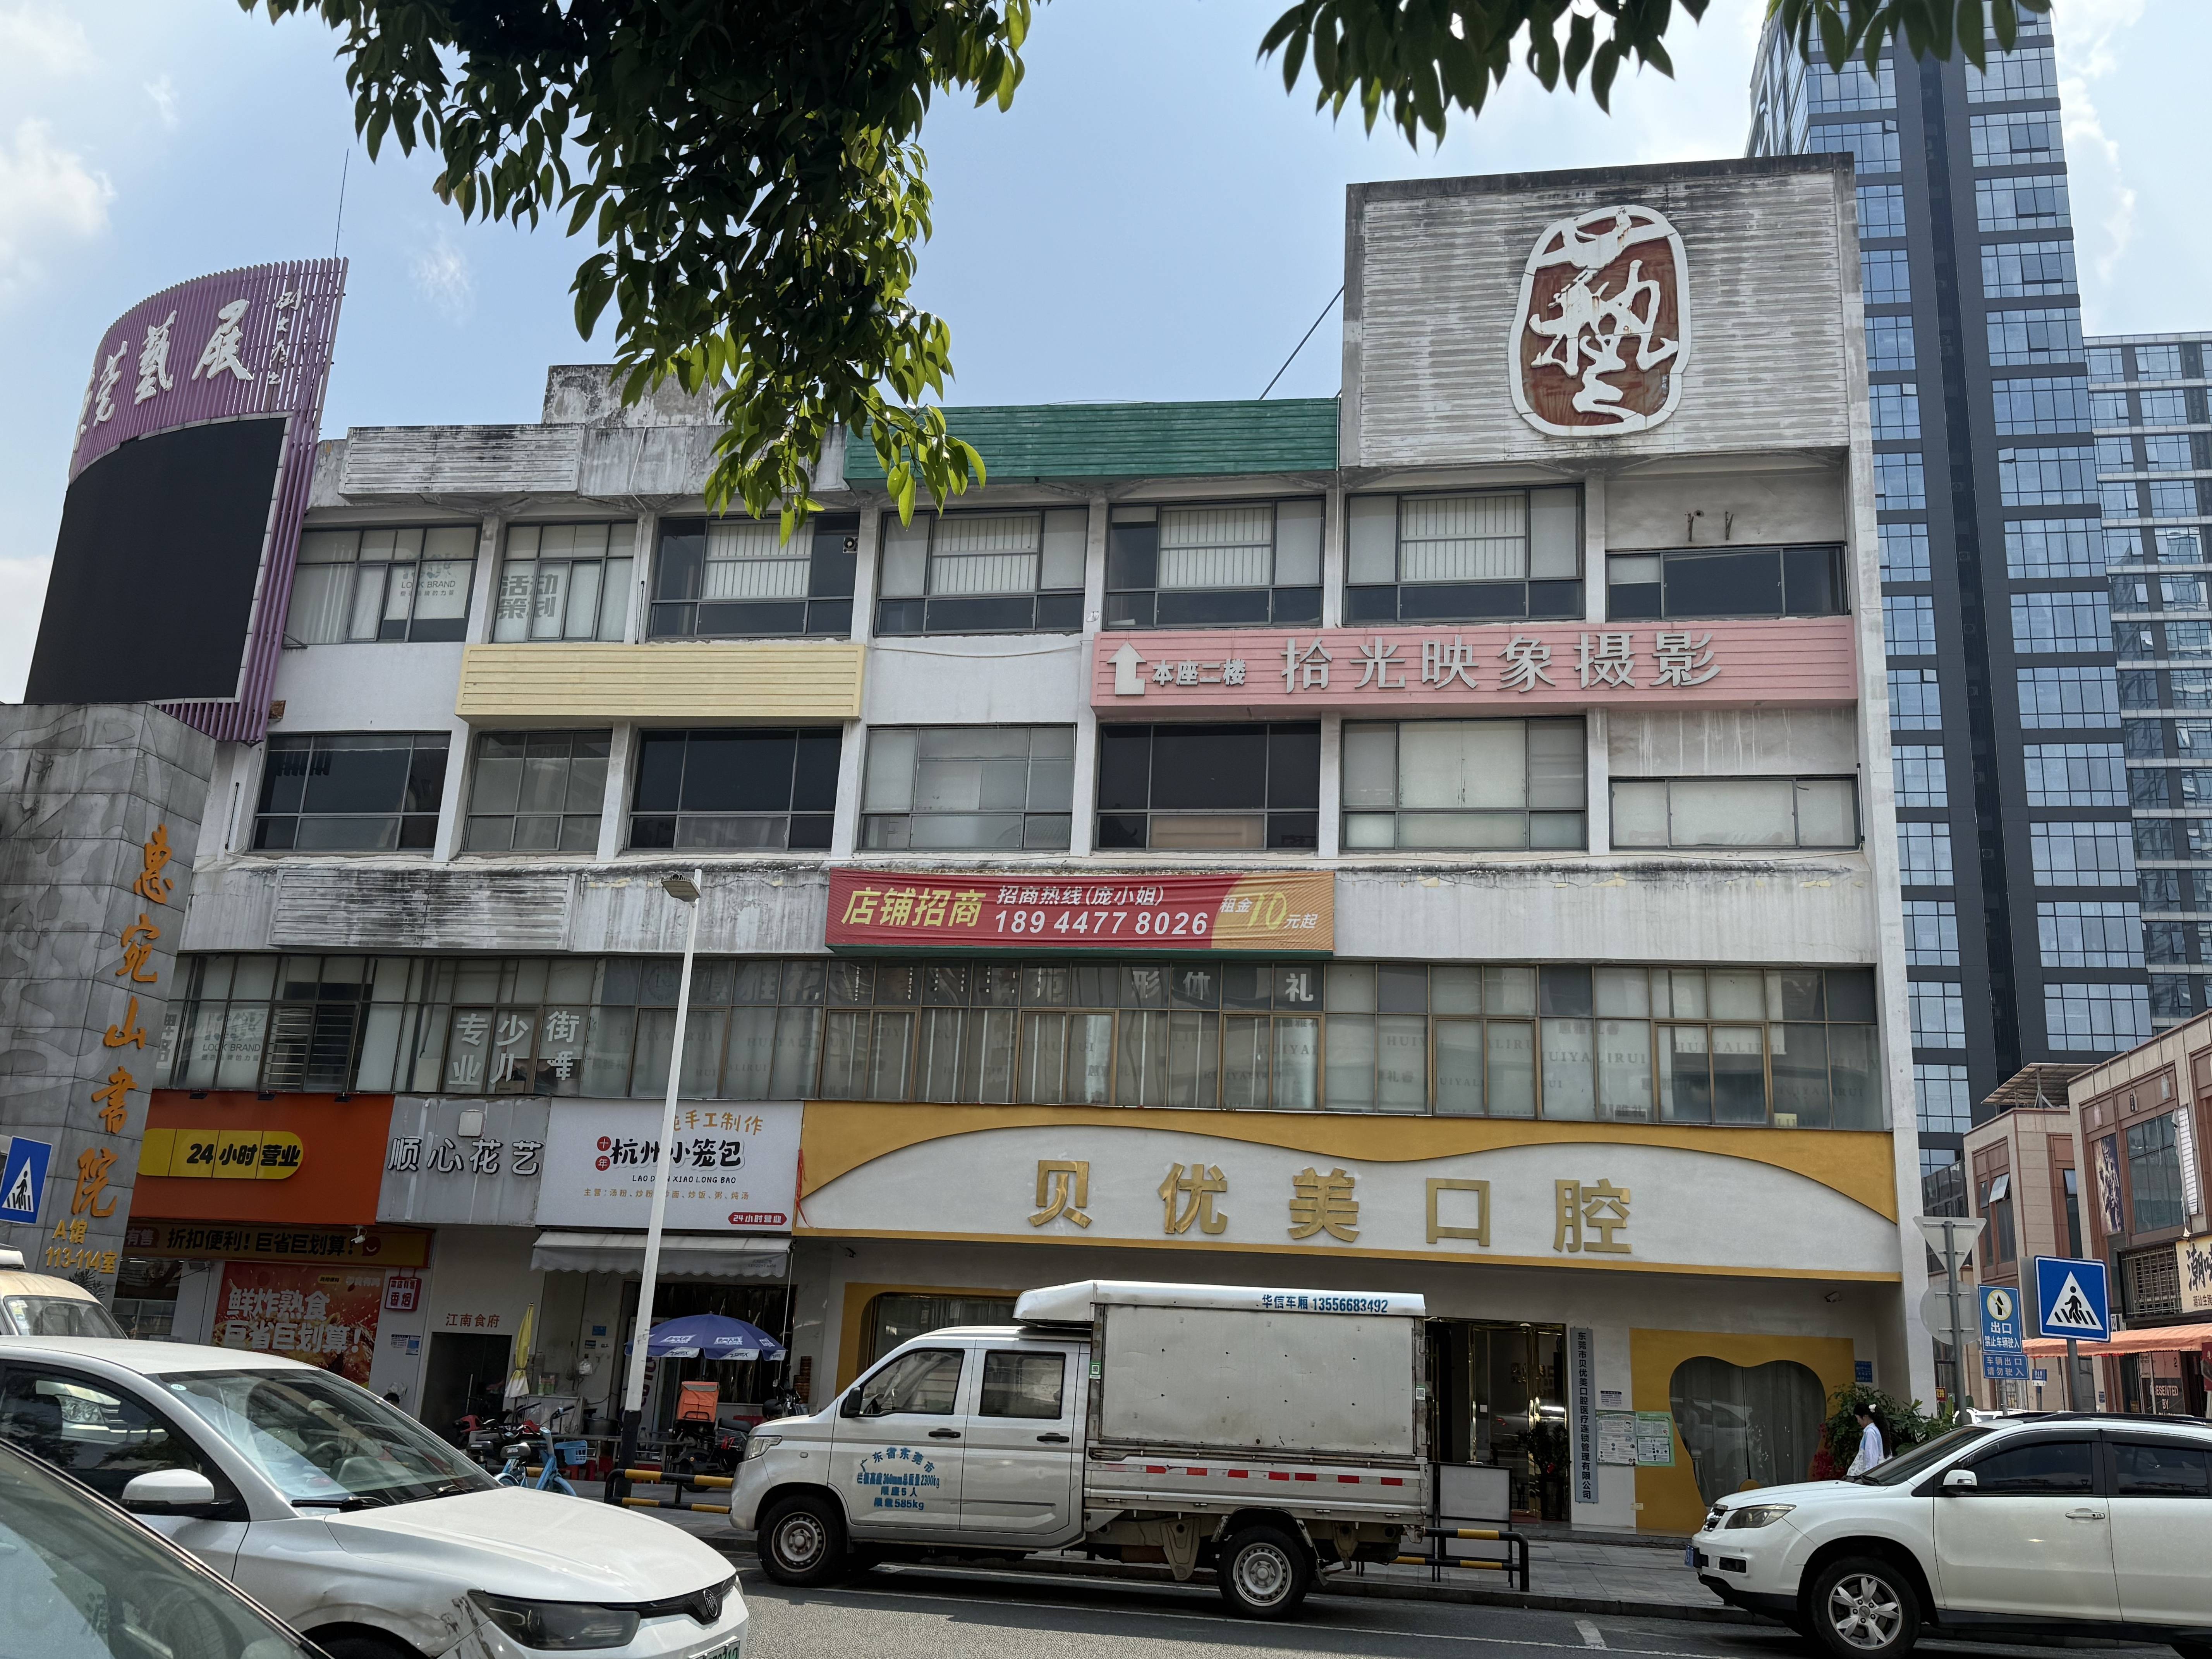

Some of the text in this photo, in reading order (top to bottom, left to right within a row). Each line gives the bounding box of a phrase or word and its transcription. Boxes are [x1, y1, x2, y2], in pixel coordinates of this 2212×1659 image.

[427, 580, 456, 588] BRAND
[1152, 631, 1722, 693] 本座二楼 拾光映象摄影
[841, 886, 986, 927] 店铺招商
[994, 910, 1209, 934] 189 4477 8026
[186, 1142, 301, 1168] 24小时营业
[387, 1136, 543, 1175] 顺心花艺
[610, 1138, 741, 1168] 杭州小笼包
[733, 1214, 782, 1224] 24小时营业
[1025, 1160, 1633, 1255] 贝优美口腔
[227, 1288, 331, 1322] 鲜炸熟食
[1262, 1294, 1389, 1313] 华信车厢 13556683492
[445, 1312, 500, 1328] 江南食府
[1990, 1321, 2012, 1334] 出口
[1984, 1335, 2020, 1348] 禁止车辆驶入
[1986, 1356, 2022, 1366] 车辆出口
[1987, 1366, 2024, 1377] 请勿驶入
[1577, 1331, 1592, 1499] 东莞市贝优美口腔医疗连锁管理有限公司
[859, 1447, 935, 1473] 广东省东莞市
